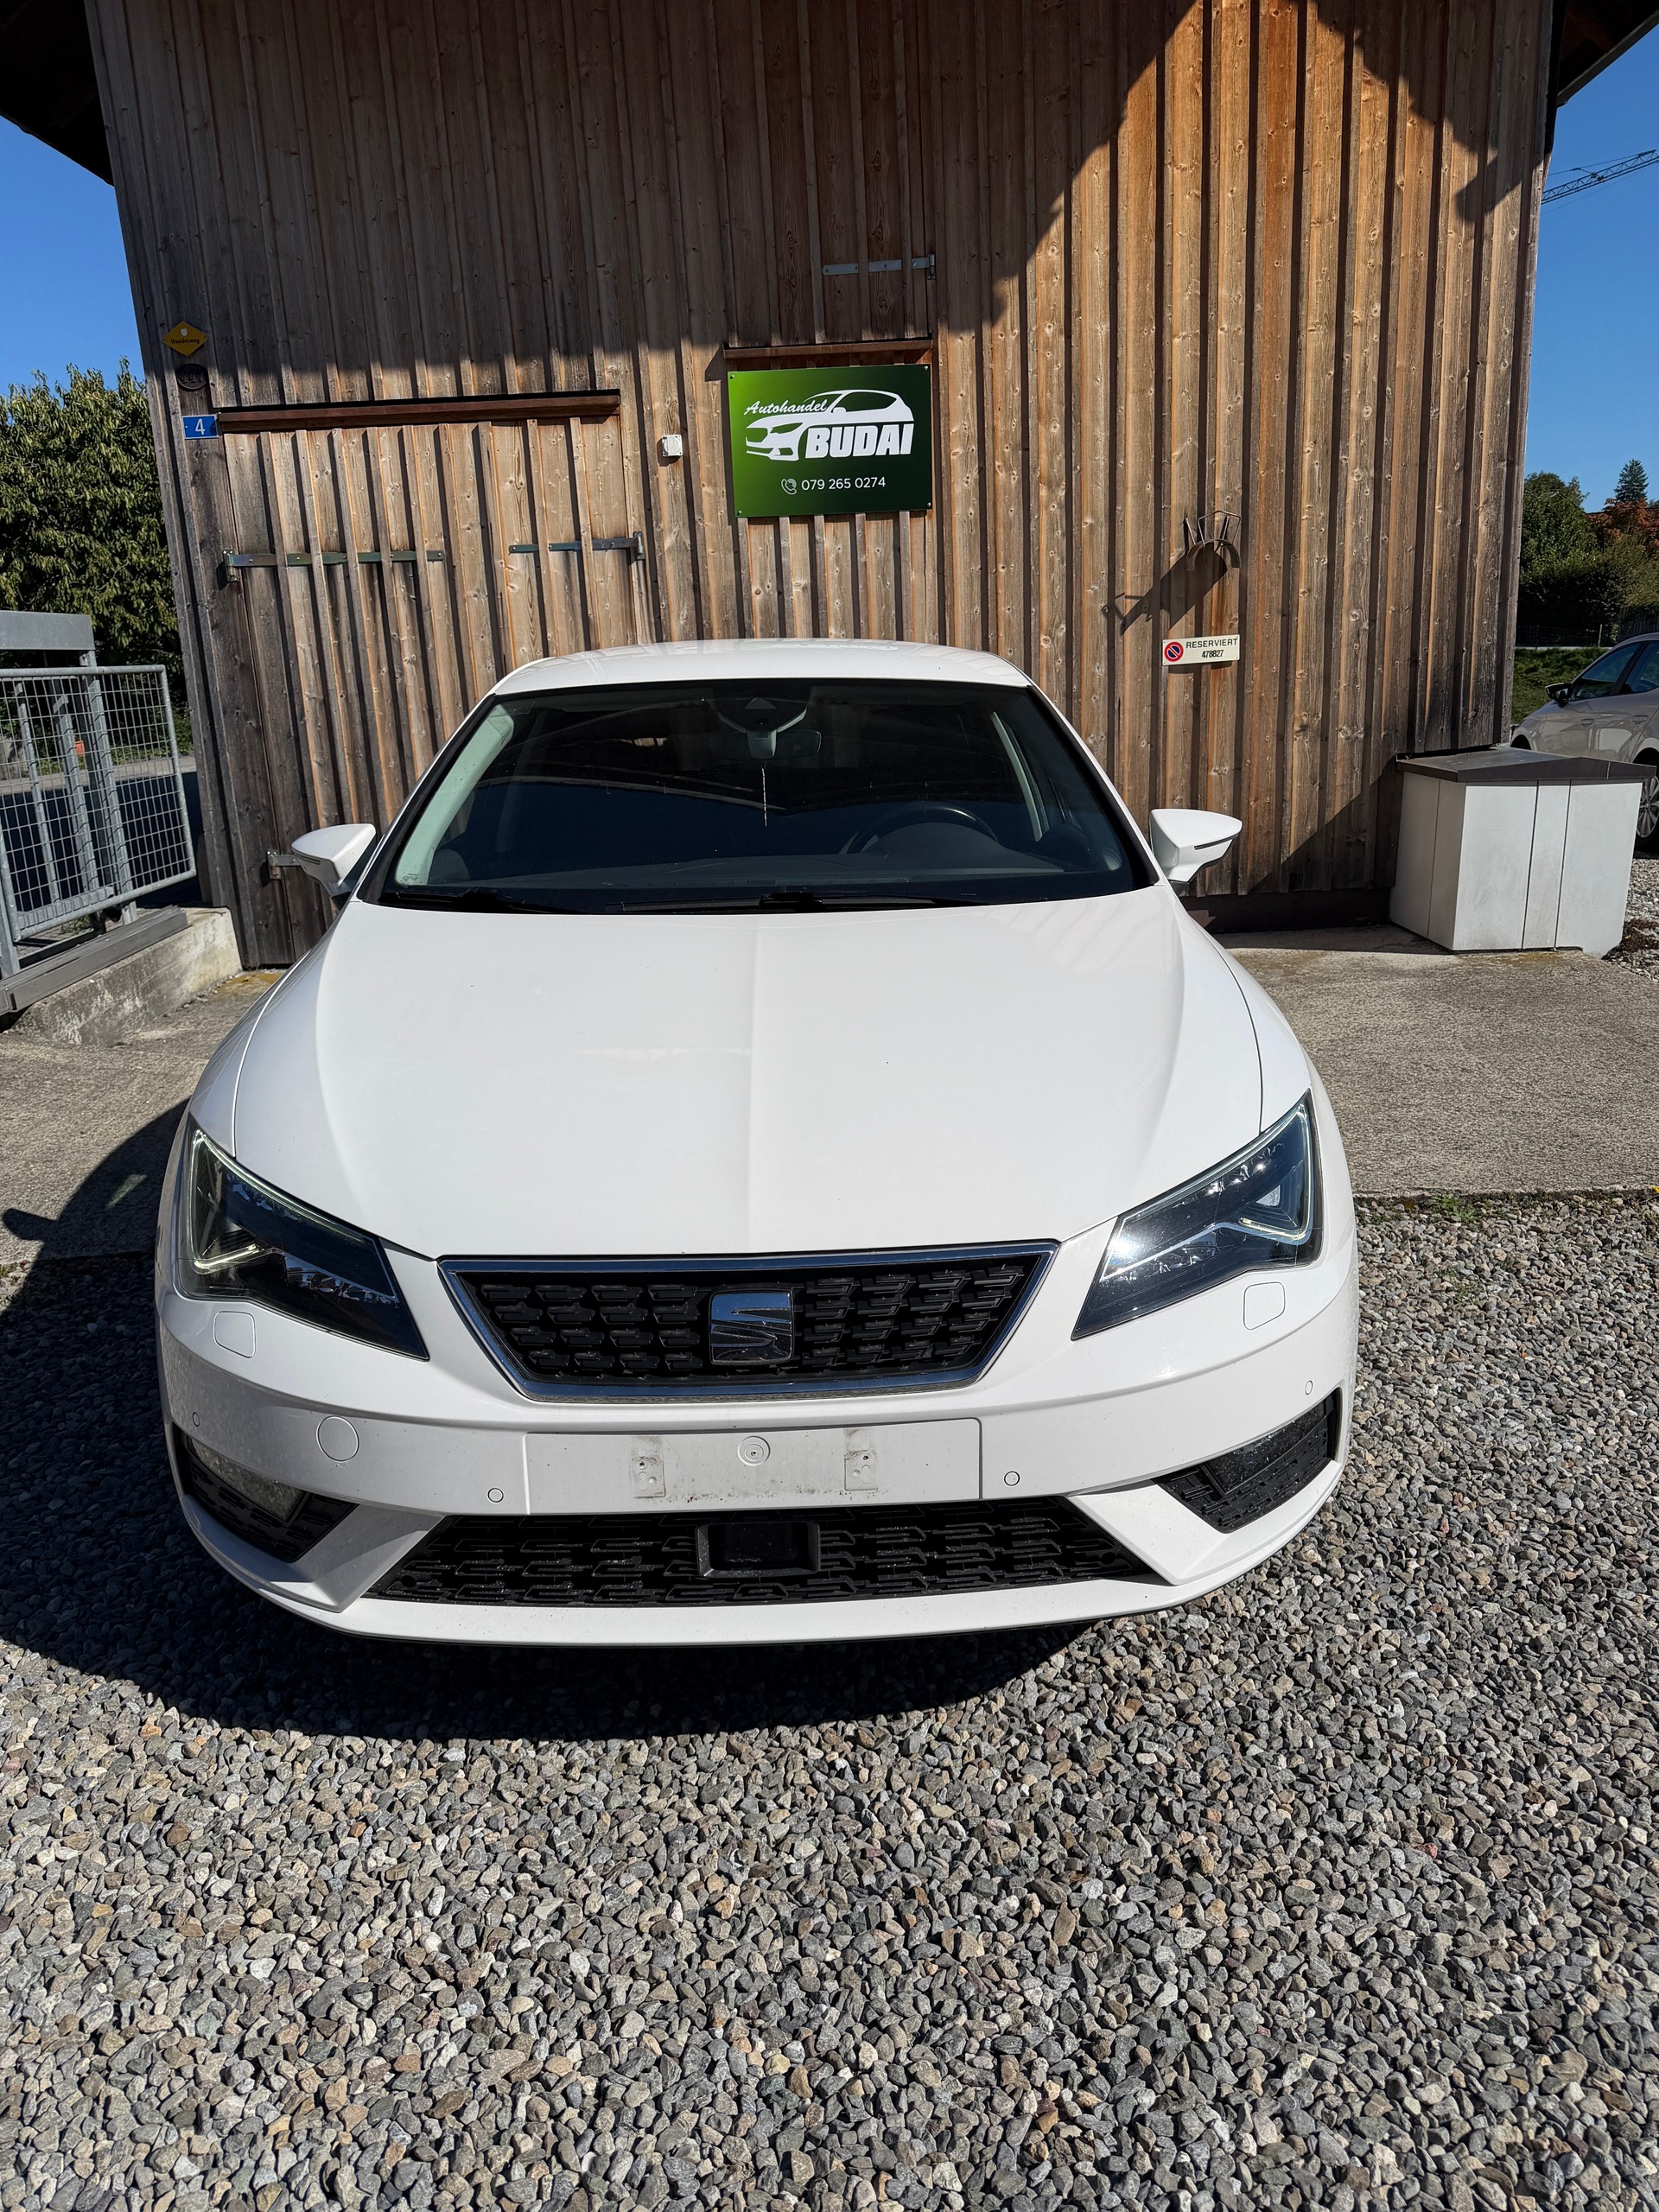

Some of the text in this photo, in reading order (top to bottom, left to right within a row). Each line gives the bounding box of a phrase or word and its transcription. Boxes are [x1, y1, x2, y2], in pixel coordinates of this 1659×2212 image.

[744, 398, 828, 416] Autohandel
[194, 418, 206, 435] 4
[804, 423, 915, 459] BUDAI
[801, 476, 887, 491] 079 265 0274
[1185, 638, 1238, 649] RESERVIERT
[1201, 649, 1224, 658] 478827
